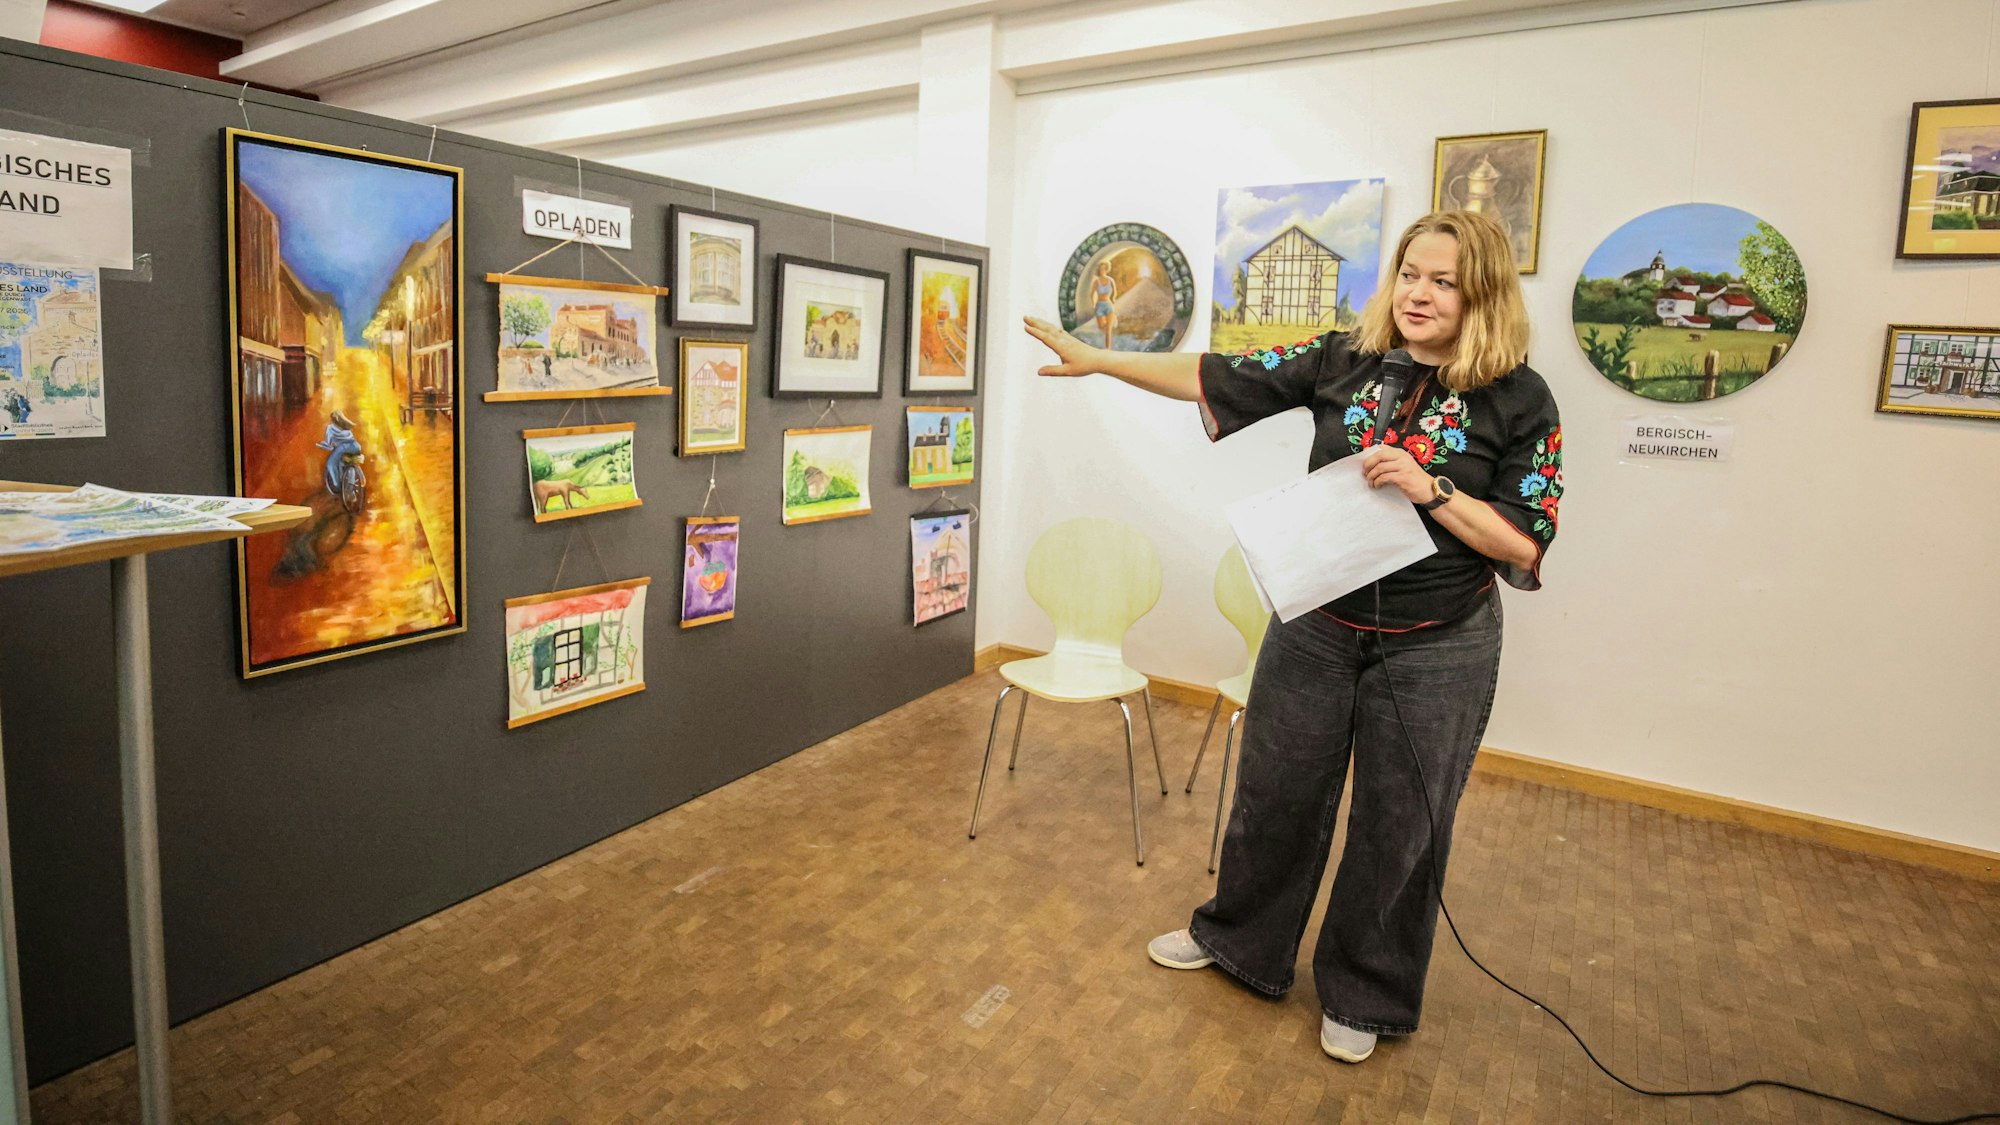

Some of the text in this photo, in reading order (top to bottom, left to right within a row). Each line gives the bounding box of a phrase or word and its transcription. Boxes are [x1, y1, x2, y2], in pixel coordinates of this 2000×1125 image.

[0, 153, 111, 187] ISCHES
[534, 209, 621, 238] OPLADEN
[0, 266, 73, 280] SSTELLUNG
[17, 284, 48, 294] LAND
[1636, 426, 1713, 440] BERGISCH-
[1628, 443, 1718, 458] NEUKIRCHEN
